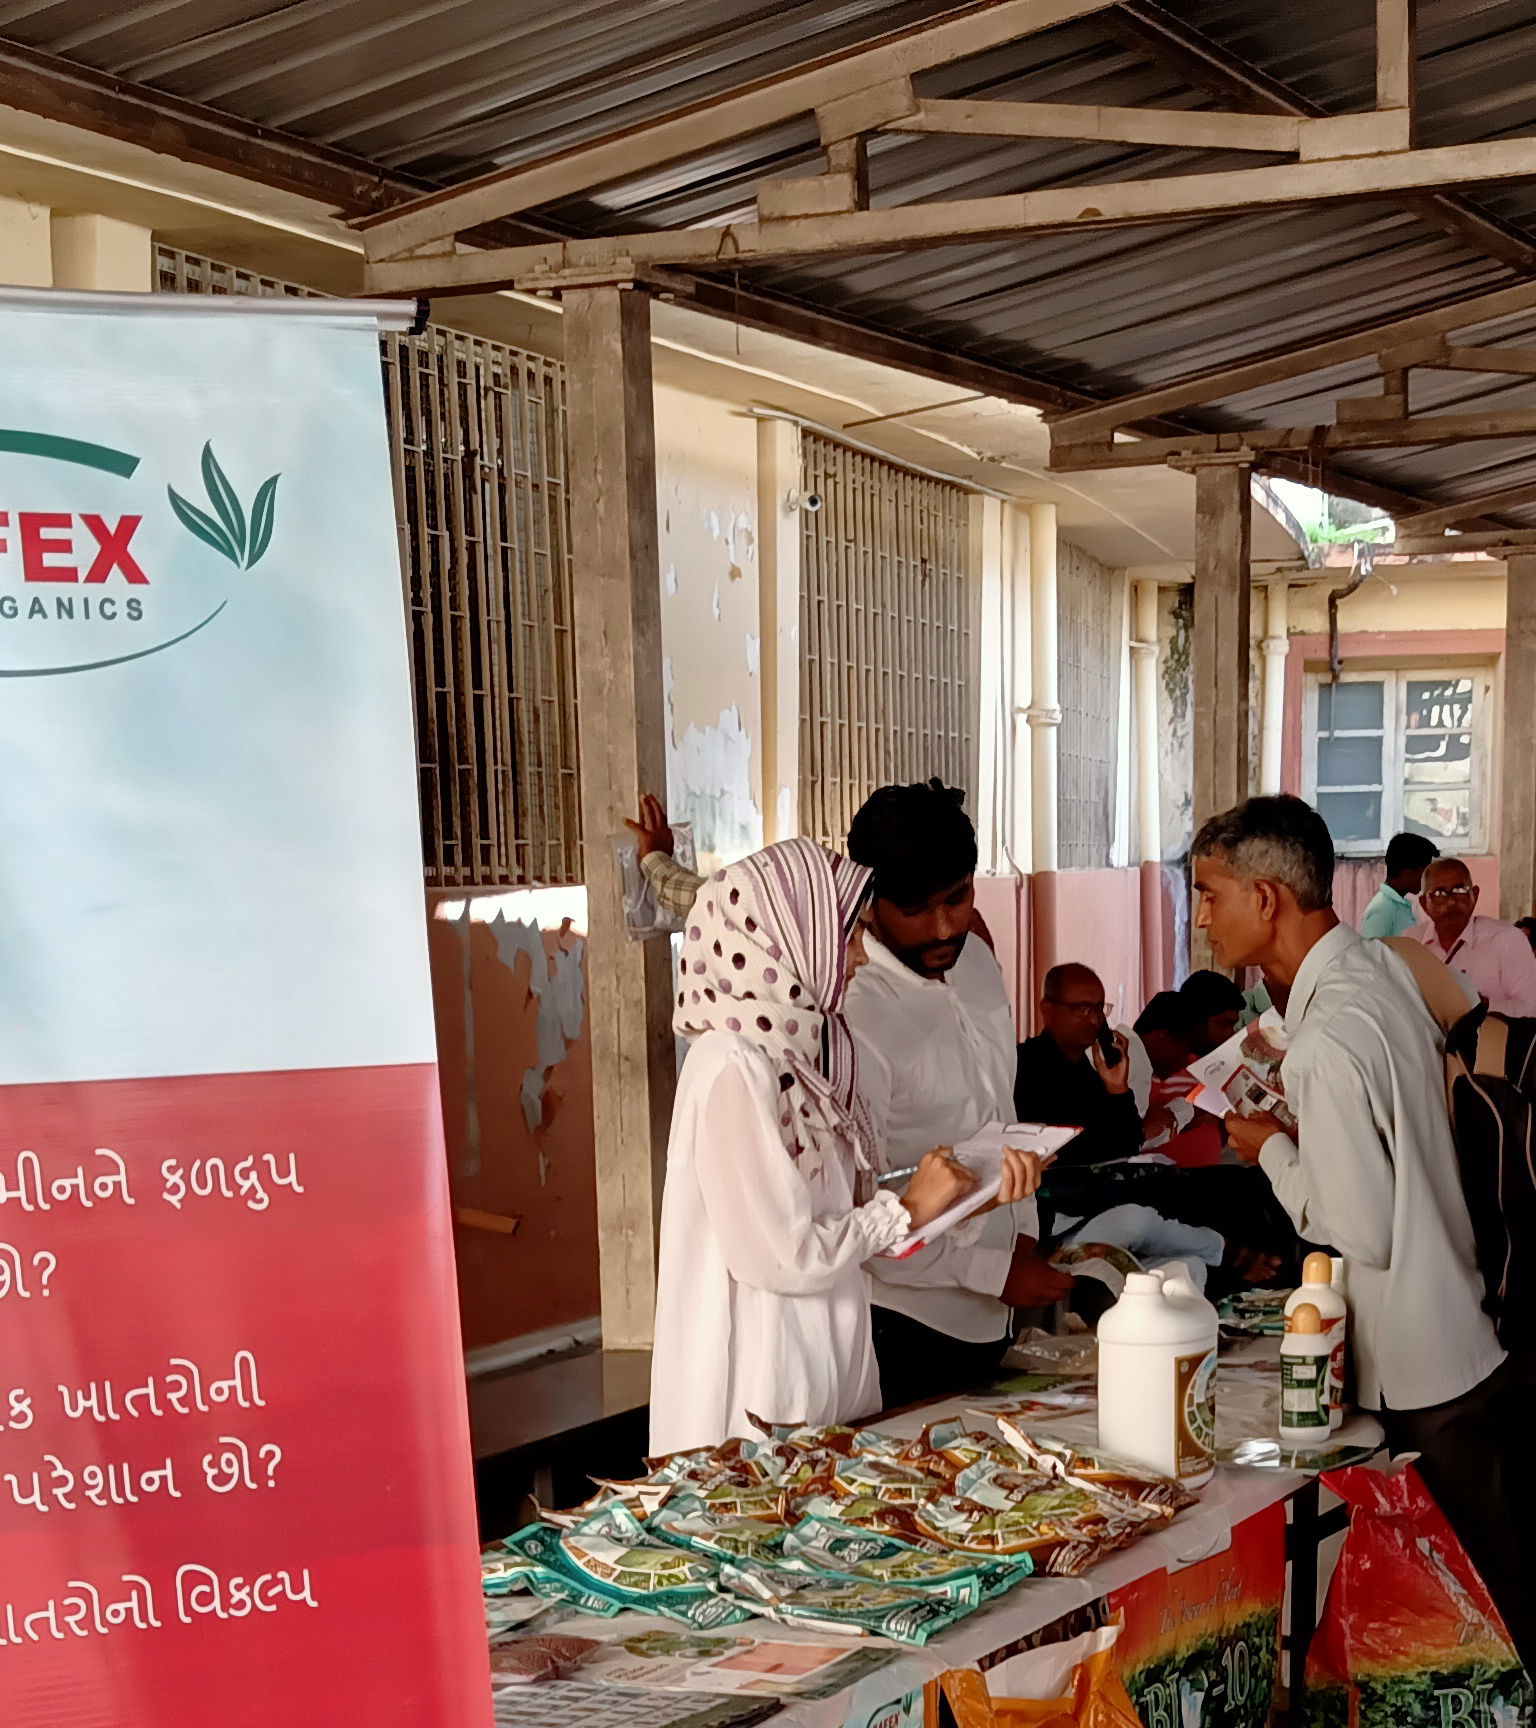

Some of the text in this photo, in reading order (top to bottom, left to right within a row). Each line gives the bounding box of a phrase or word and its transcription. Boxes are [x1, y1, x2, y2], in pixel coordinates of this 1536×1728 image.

[57, 1350, 267, 1424] ખાતરોની
[4, 1454, 183, 1516] પરેશાન
[203, 1436, 284, 1496] છો?
[175, 1563, 320, 1627] વિકલ્પ
